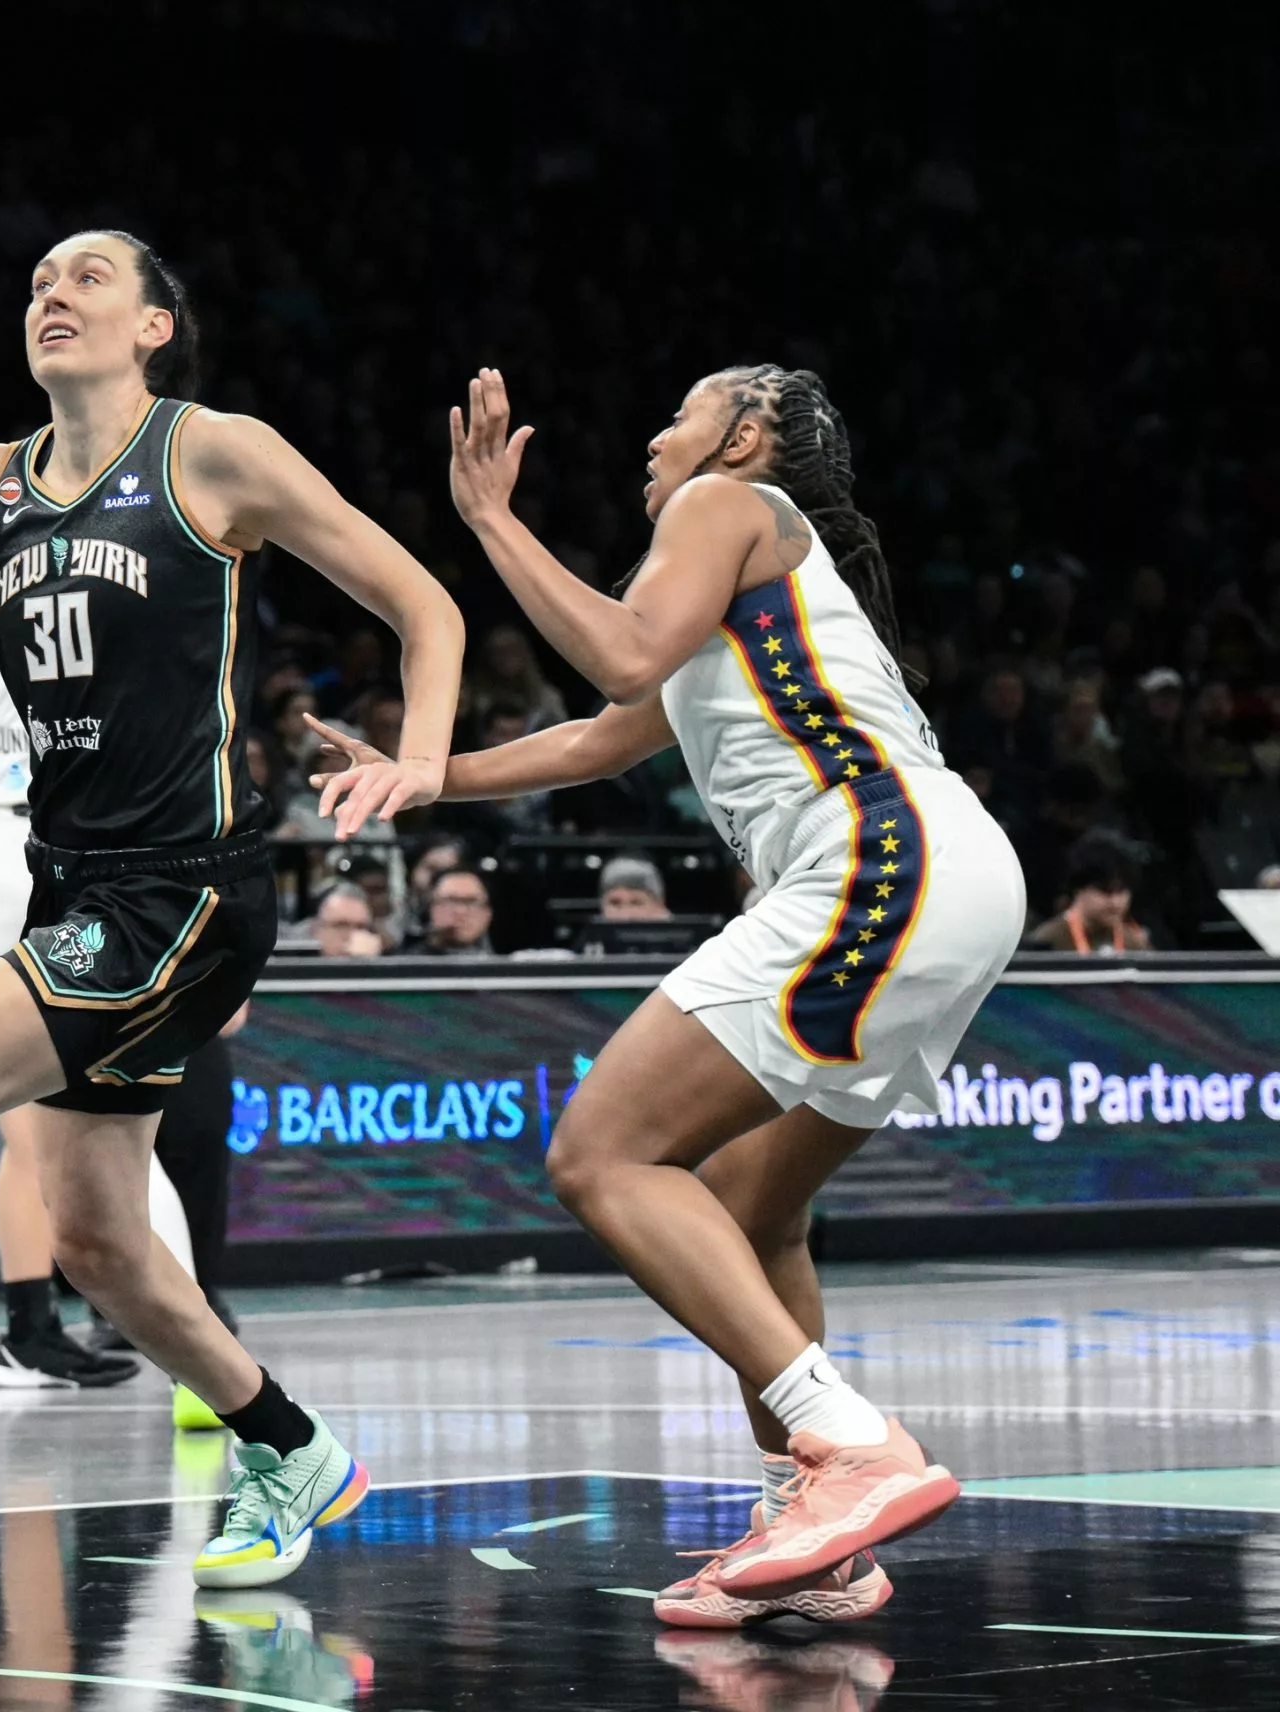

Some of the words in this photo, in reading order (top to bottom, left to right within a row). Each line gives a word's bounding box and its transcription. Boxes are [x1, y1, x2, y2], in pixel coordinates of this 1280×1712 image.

[104, 494, 151, 509] BARCLAYS
[69, 538, 148, 599] YORK
[23, 590, 94, 682] 30
[56, 733, 100, 750] utual
[277, 1080, 526, 1145] BARCLAYS
[1068, 1061, 1253, 1125] Partner
